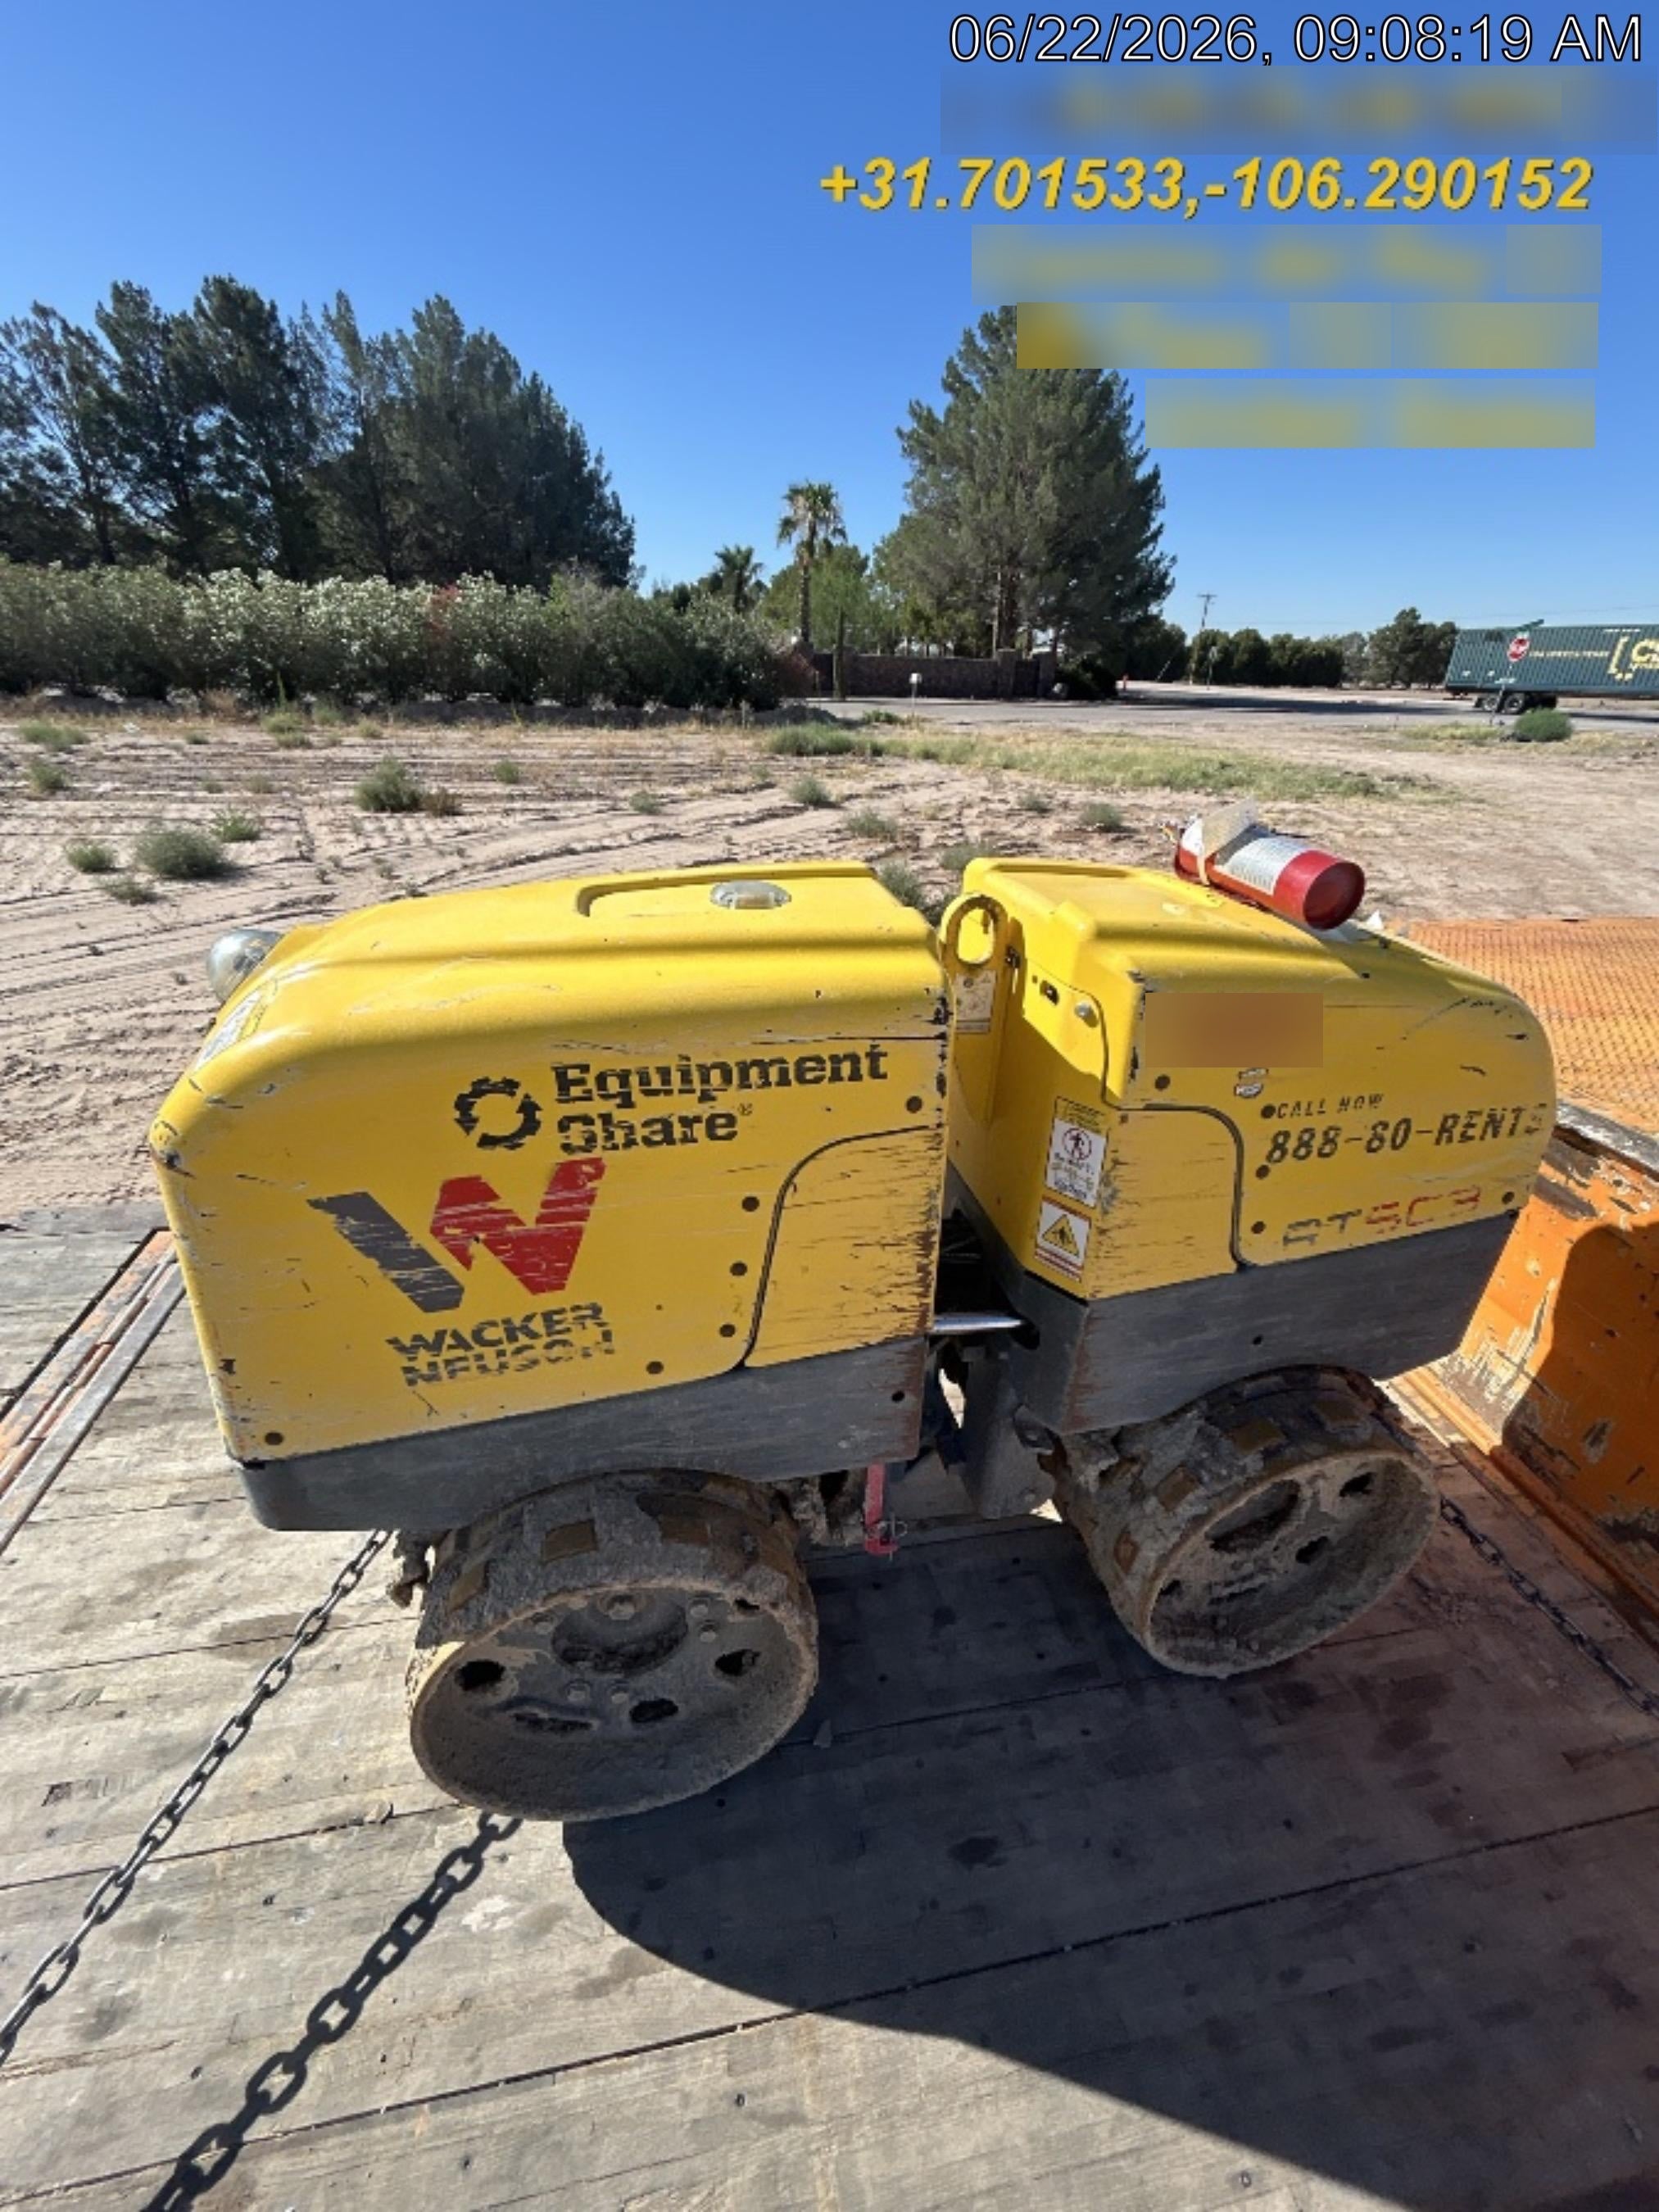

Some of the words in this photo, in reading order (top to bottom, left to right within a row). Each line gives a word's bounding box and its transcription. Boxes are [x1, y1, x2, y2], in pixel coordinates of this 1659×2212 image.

[551, 1044, 889, 1108] Equipment
[1276, 1099, 1327, 1119] CALL
[384, 1302, 610, 1362] WACKER
